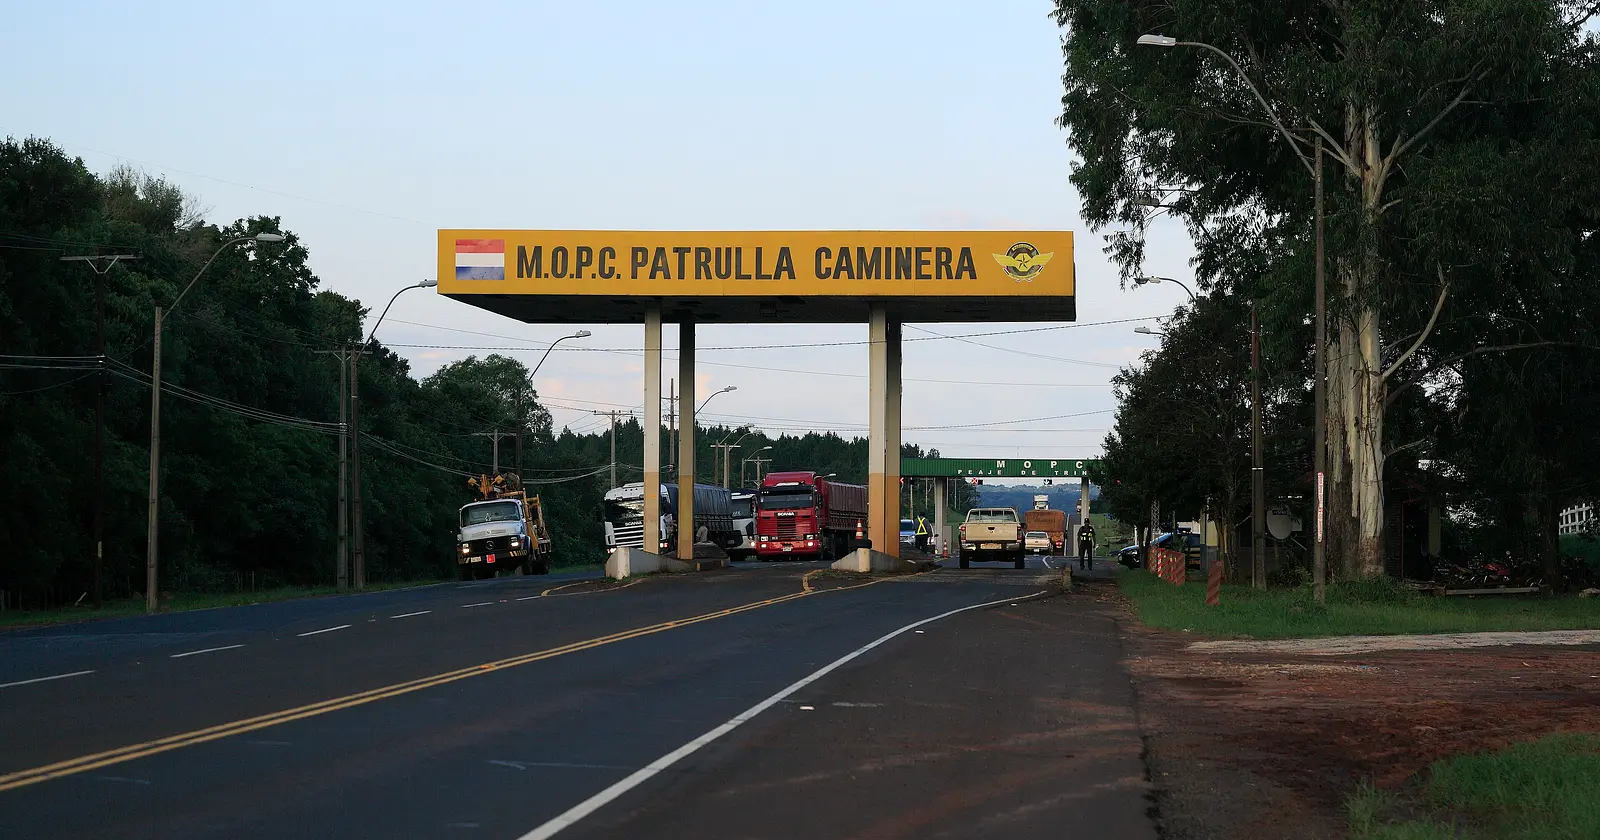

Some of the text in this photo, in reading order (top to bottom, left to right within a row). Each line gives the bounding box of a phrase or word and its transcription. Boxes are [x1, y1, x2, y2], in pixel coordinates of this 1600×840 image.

[517, 246, 977, 280] M.O.P.C. PATRULLA CAMINERA
